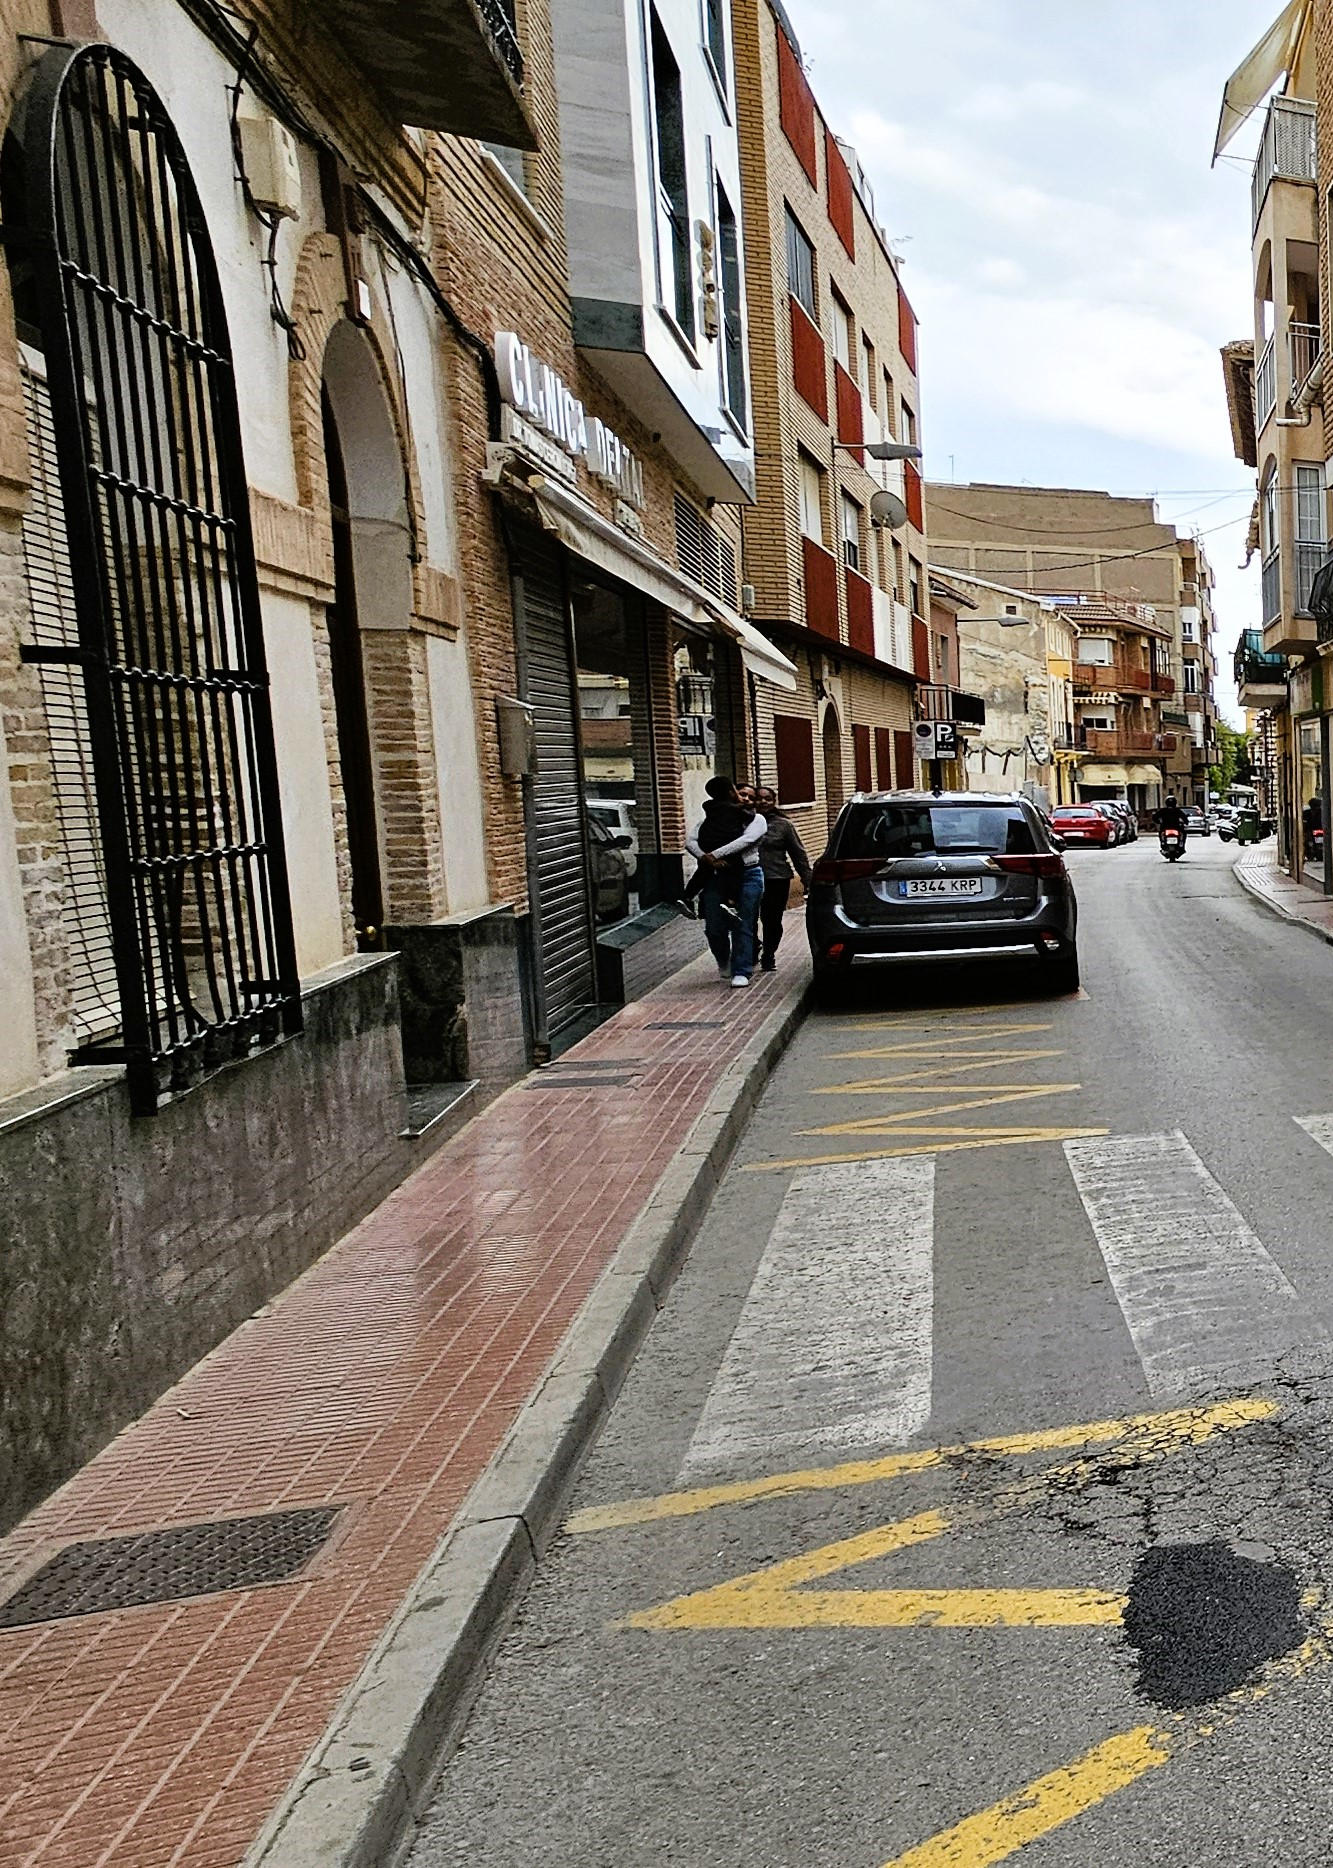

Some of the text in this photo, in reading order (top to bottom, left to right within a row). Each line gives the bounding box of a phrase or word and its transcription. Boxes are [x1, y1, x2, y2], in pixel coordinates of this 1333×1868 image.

[936, 724, 953, 742] P
[910, 879, 977, 892] 3344 KRP
